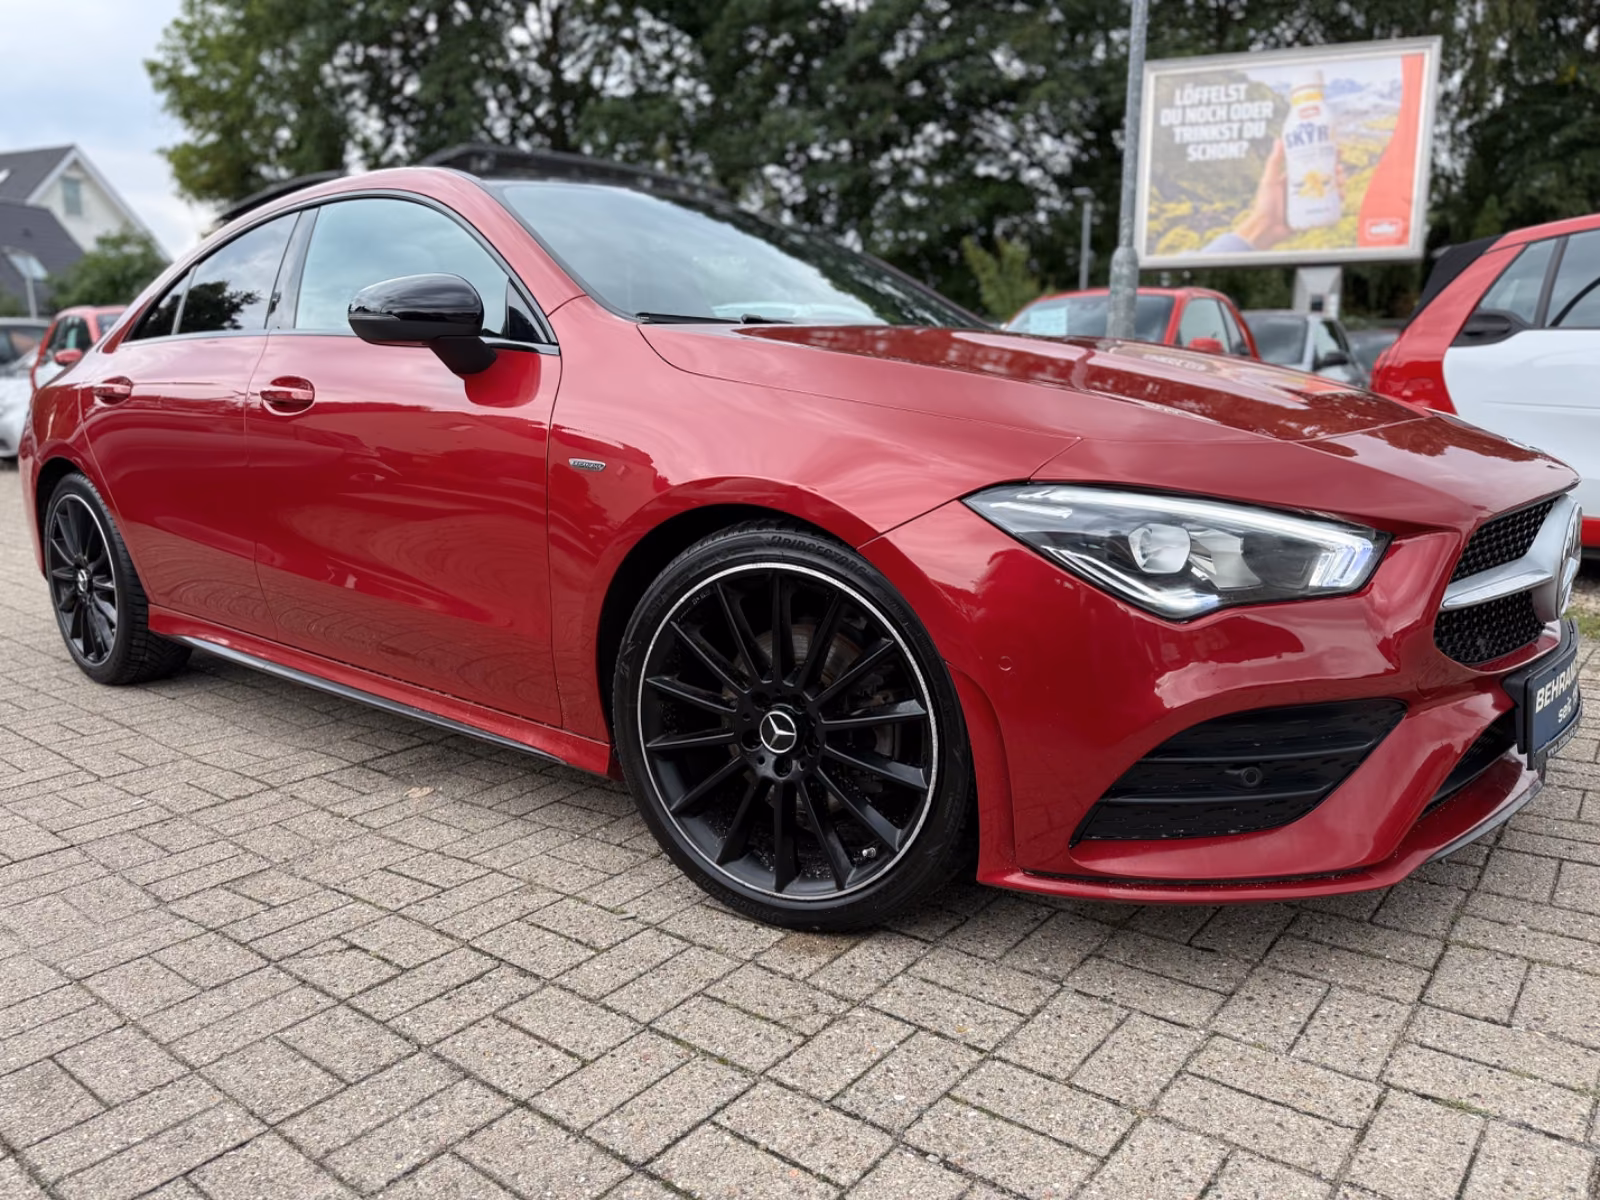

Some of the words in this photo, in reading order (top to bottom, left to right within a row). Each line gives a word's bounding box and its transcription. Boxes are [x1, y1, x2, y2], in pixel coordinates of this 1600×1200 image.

[1174, 83, 1248, 106] LÖFFELST
[1160, 107, 1183, 126] DU
[1185, 104, 1228, 123] NOCH
[1230, 101, 1274, 120] ODER
[1173, 123, 1241, 144] TRINKST
[1242, 120, 1266, 139] DU
[1285, 121, 1330, 149] SKYR
[1187, 141, 1250, 162] SCHON?
